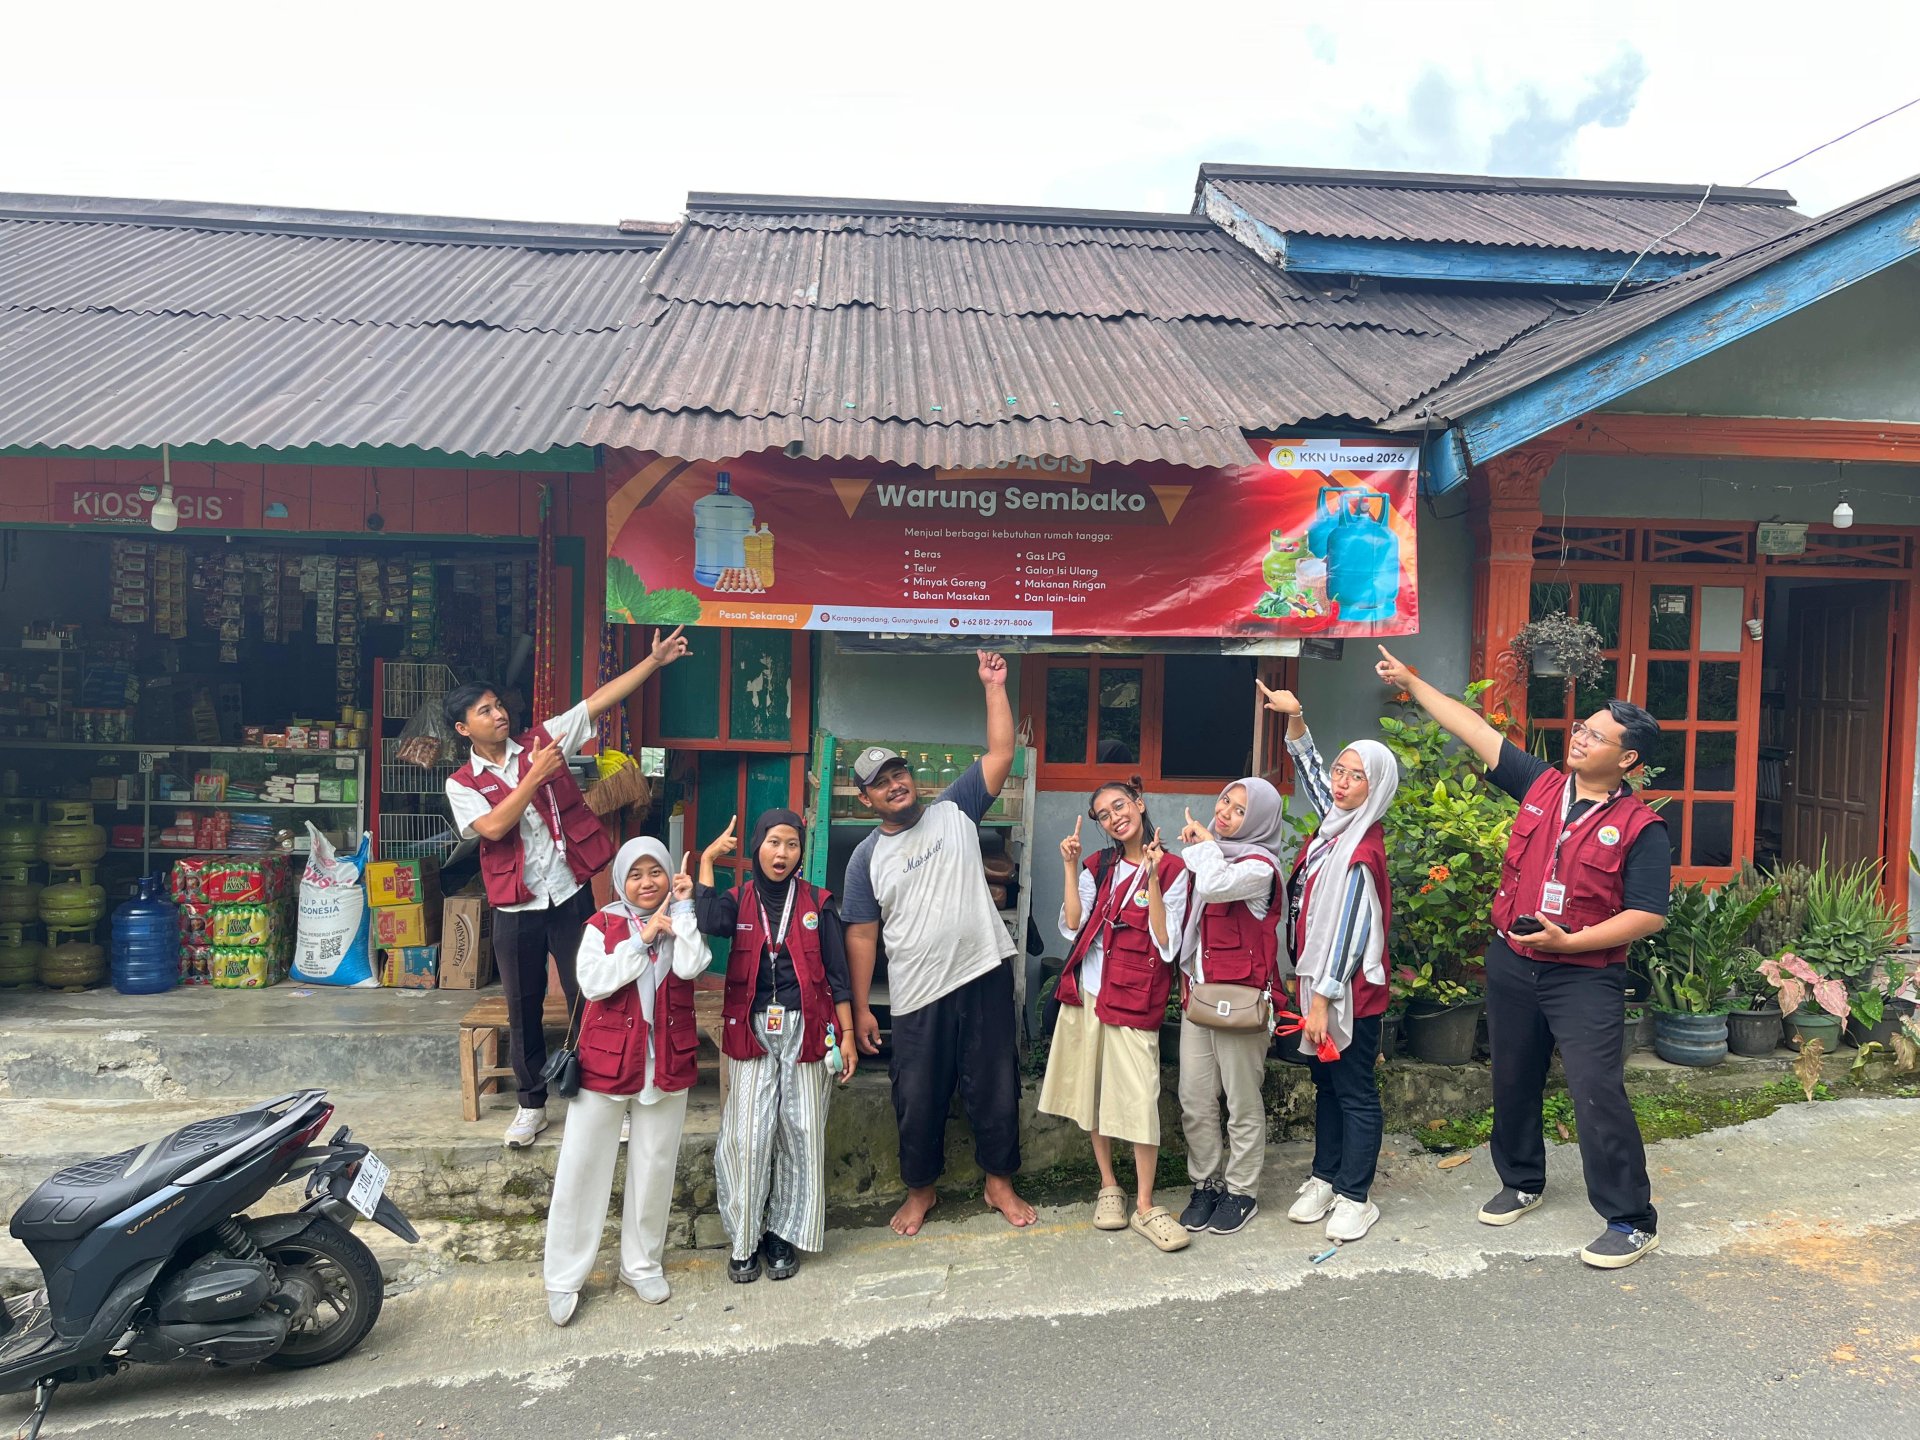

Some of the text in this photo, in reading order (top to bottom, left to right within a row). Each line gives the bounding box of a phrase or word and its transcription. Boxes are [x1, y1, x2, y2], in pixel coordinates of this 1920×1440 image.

[1300, 452, 1405, 463] KKN Unsoed 2026
[1016, 454, 1086, 474] AGIS
[73, 491, 223, 520] KIOS GIS
[877, 484, 1146, 517] Warung Sembako
[904, 528, 1113, 543] Menjual berbagai kebutuhan rumah tangga:
[914, 549, 942, 559] Beras
[1025, 551, 1066, 561] Gas LPG
[913, 563, 936, 573] Telur
[1025, 566, 1098, 578] Galon Isi Ulang
[913, 577, 987, 589] Minyak Goreng
[1025, 579, 1106, 591] Makanan Ringan
[913, 591, 990, 601] Bahan Masakan
[1024, 593, 1086, 603] Dan lain-lain
[719, 610, 798, 623] Pesan Sekarang!
[891, 616, 939, 626] Gunungwuled
[961, 618, 1033, 627] +62 812-2971-8006
[223, 881, 252, 892] JAVANA
[300, 906, 340, 915] NDONESIA
[228, 924, 252, 936] JAVANA
[225, 965, 250, 978] JAVANA
[351, 1195, 361, 1207] R
[357, 1169, 373, 1194] 3104
[126, 1195, 186, 1235] VARIO
